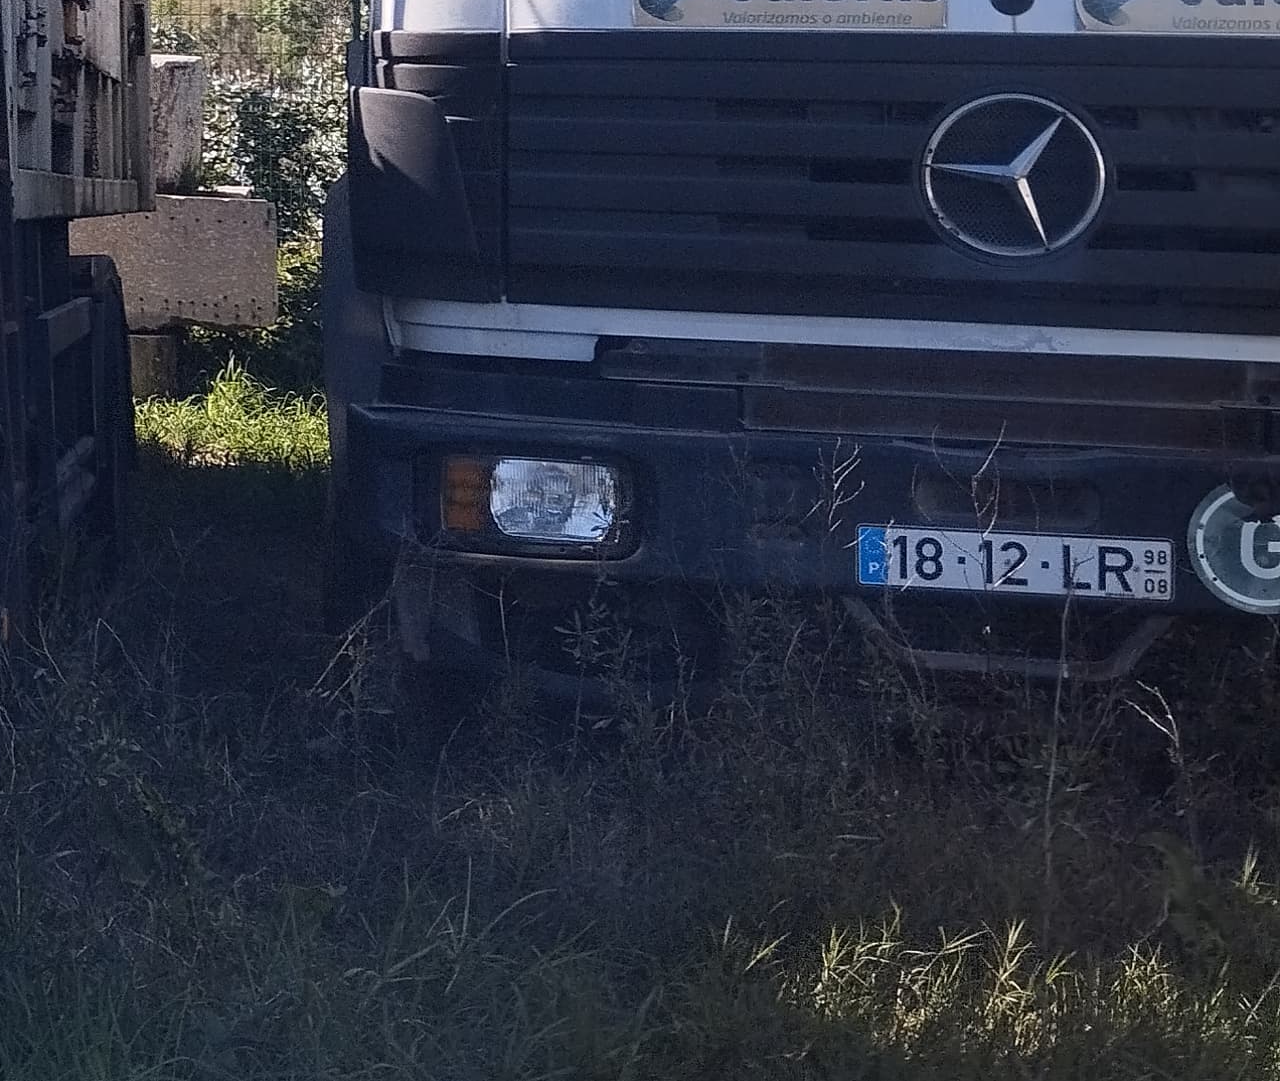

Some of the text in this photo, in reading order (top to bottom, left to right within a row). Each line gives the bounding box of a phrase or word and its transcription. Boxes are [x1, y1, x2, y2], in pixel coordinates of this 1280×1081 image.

[834, 11, 913, 26] ambiente
[1143, 549, 1168, 566] 98
[1143, 578, 1168, 594] 08
